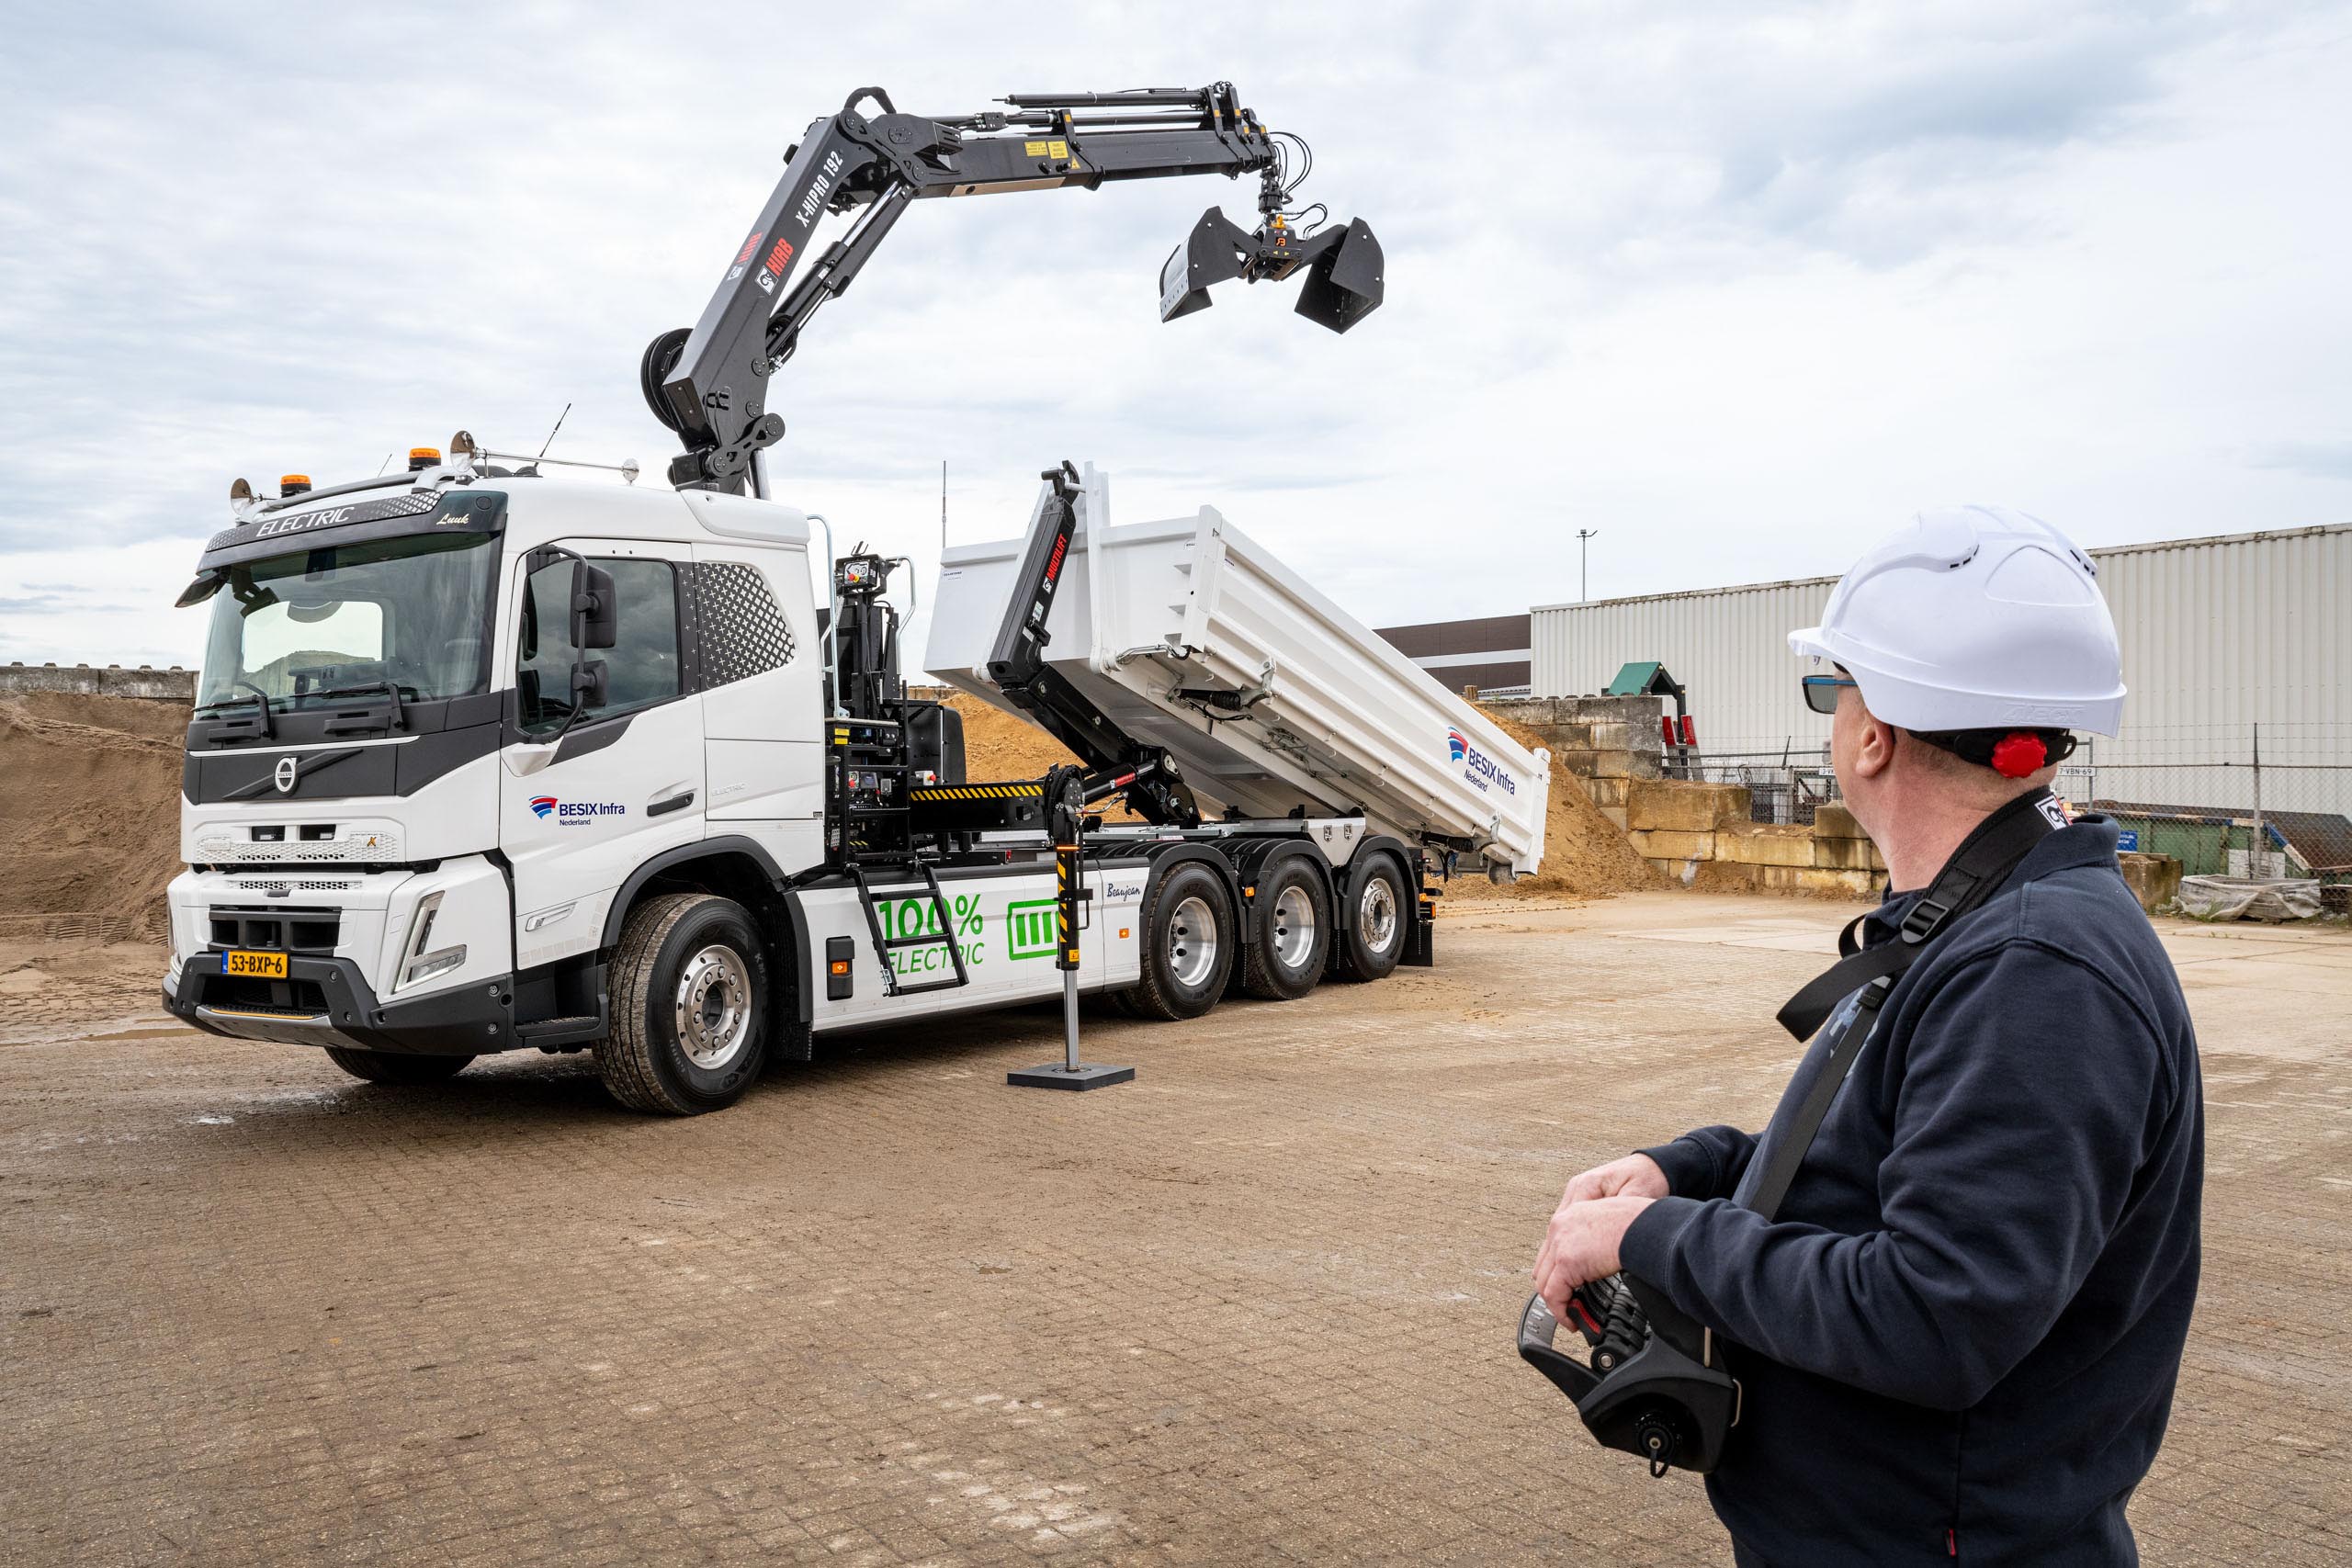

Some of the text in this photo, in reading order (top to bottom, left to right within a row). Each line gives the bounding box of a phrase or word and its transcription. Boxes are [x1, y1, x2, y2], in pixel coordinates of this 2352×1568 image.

[796, 151, 843, 228] X-HIPRO 192
[766, 237, 795, 276] HIAB
[255, 506, 356, 537] ELECTRIC
[436, 513, 469, 525] Luuk
[1046, 533, 1067, 581] MULTILIFT
[1464, 769, 1488, 792] Nederland
[1468, 747, 1516, 795] BESIX Infra
[560, 802, 626, 817] BESIX Infra
[560, 818, 591, 827] Nederland
[1107, 883, 1140, 902] Beaujean
[878, 894, 984, 941] 100%
[232, 954, 283, 974] 53-BXP-6
